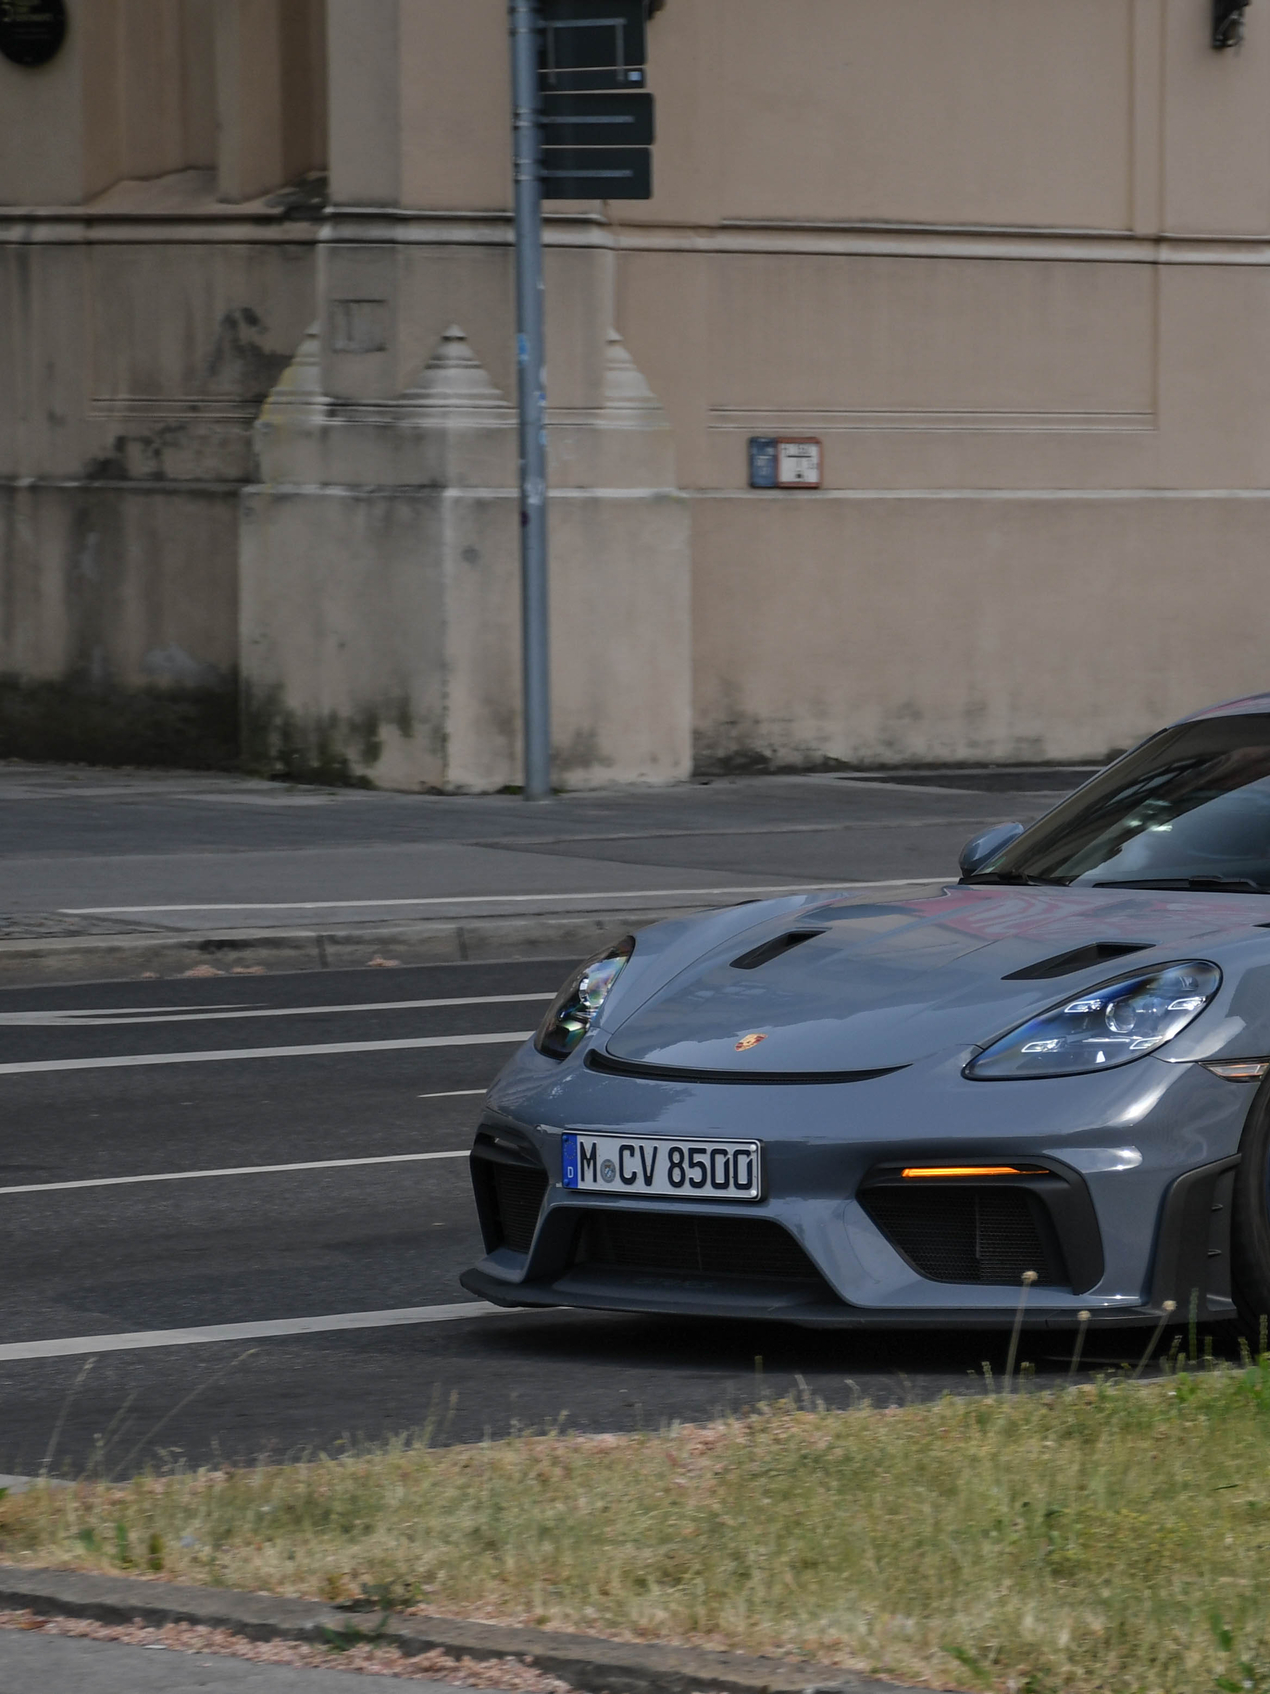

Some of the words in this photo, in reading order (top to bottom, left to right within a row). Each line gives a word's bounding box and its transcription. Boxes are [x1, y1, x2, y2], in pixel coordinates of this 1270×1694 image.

[567, 1166, 574, 1178] D
[580, 1141, 598, 1183] M
[618, 1144, 658, 1187] CV
[668, 1146, 753, 1190] 8500
